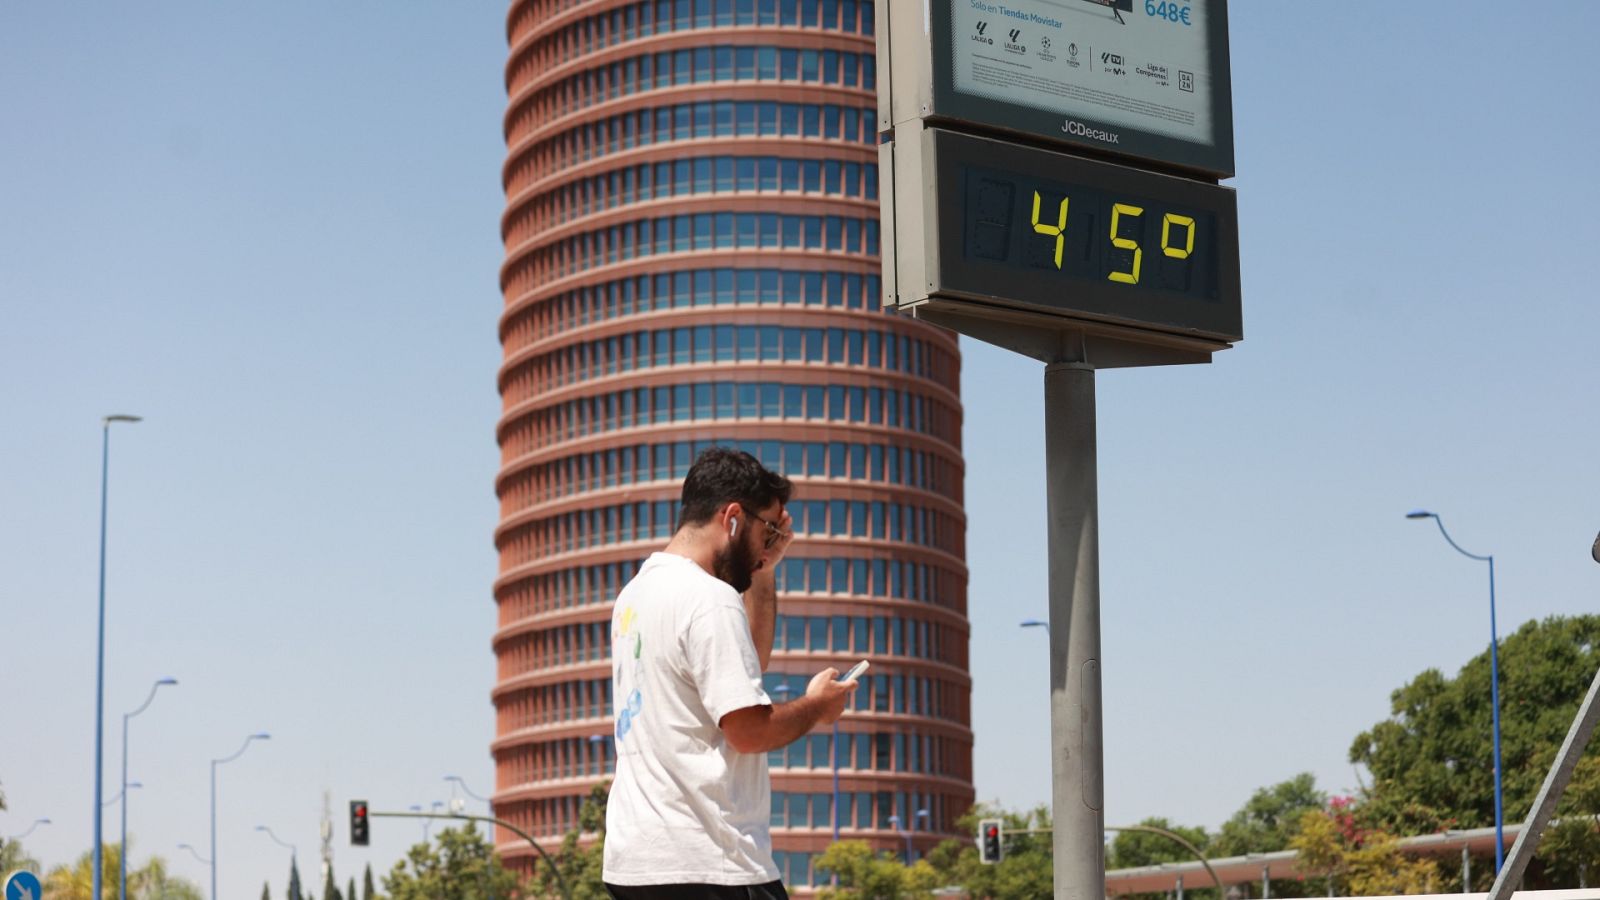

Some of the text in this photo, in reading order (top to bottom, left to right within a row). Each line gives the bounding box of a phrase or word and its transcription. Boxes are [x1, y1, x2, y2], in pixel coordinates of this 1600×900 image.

[971, 0, 1062, 28] Solo en Tiendas Movistar
[1145, 0, 1191, 26] 648€
[1061, 120, 1119, 144] JCDecaux
